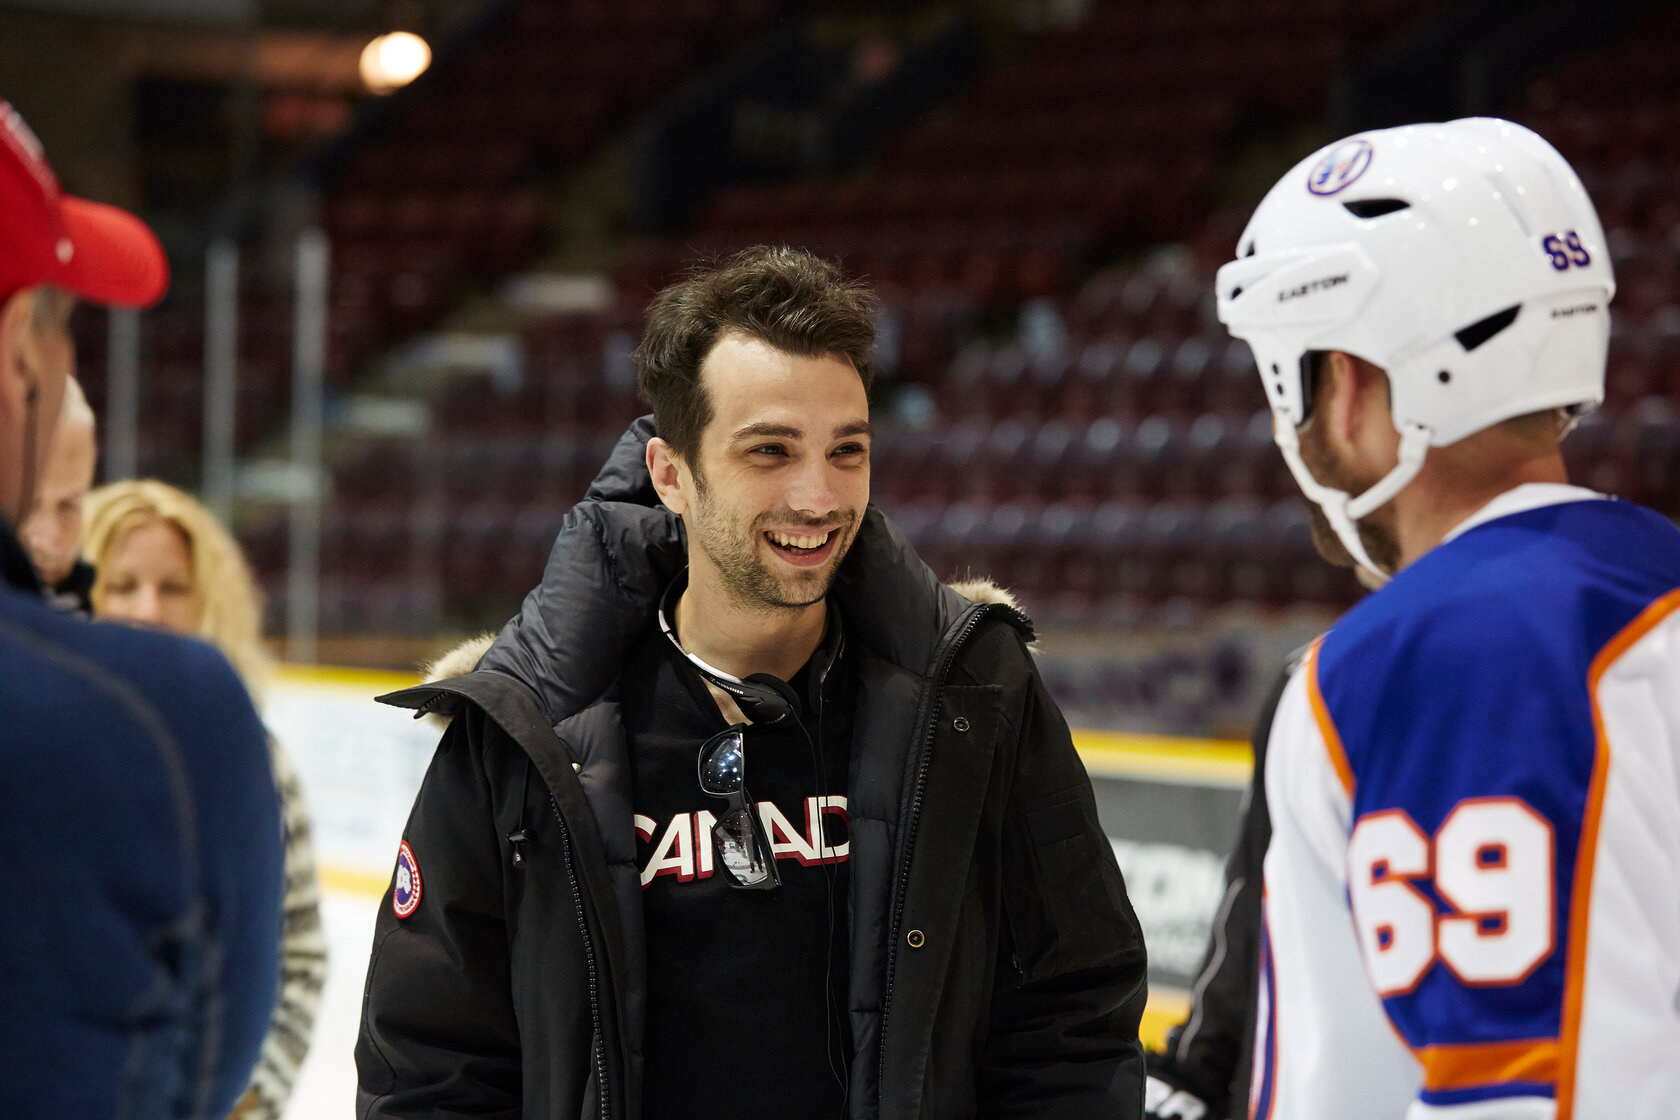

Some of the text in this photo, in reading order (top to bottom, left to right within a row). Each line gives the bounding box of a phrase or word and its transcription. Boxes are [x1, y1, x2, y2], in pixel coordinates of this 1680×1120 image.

[1543, 231, 1591, 271] 69
[1278, 273, 1349, 303] EASTON
[1348, 796, 1556, 999] 69
